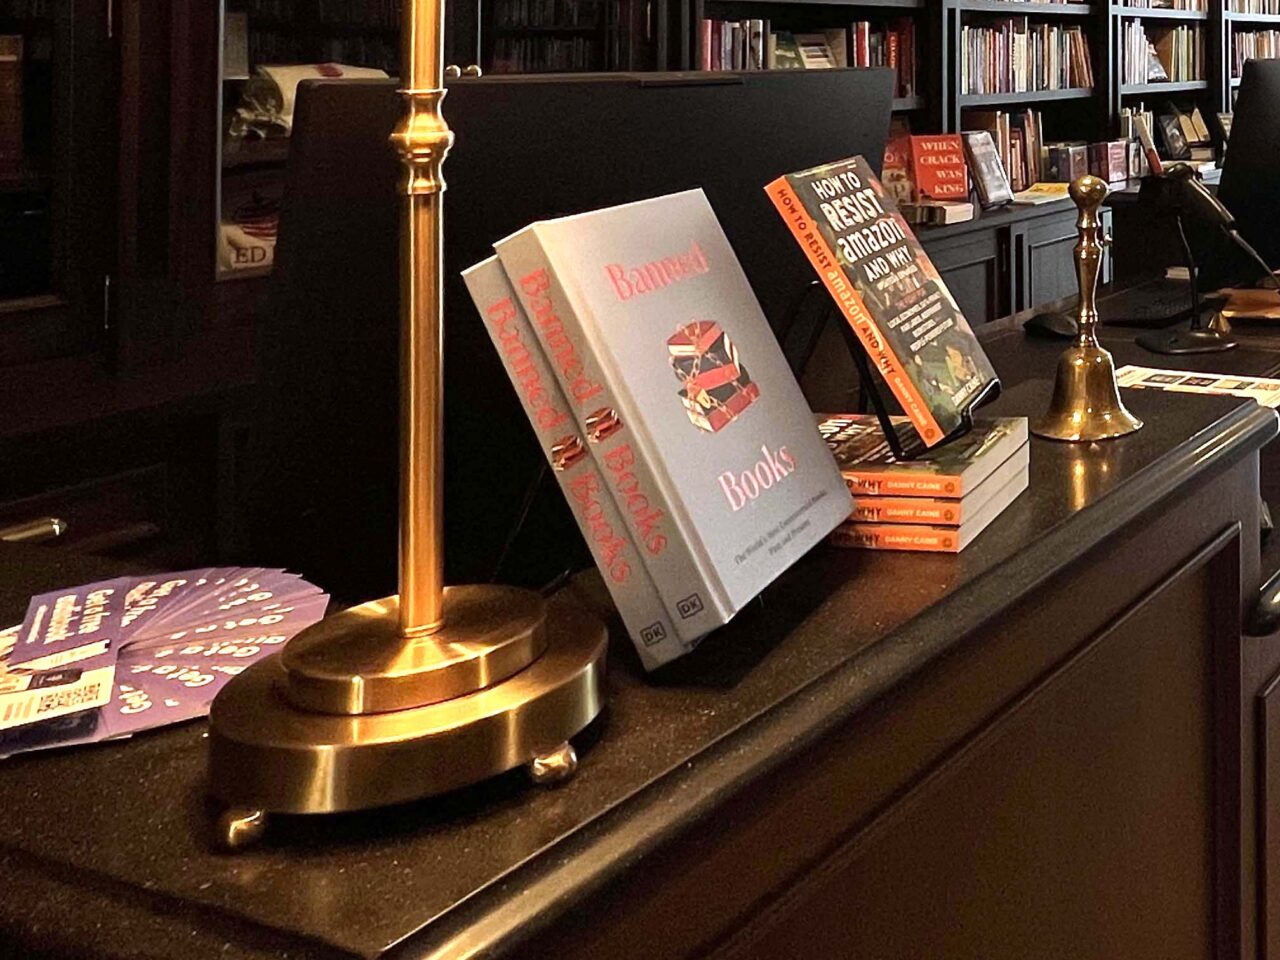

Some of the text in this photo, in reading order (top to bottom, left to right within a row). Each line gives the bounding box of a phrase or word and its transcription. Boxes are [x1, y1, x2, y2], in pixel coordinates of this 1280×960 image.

[920, 154, 961, 165] CRACK
[921, 140, 960, 152] WHEN
[811, 171, 861, 200] HOW TO
[934, 183, 964, 194] KING
[936, 169, 963, 179] WAS
[820, 188, 884, 232] RESIST
[837, 219, 907, 264] amazon
[604, 239, 711, 302] Banned
[862, 256, 890, 282] AND
[886, 244, 913, 268] WHY
[777, 188, 929, 428] HOW TO RESIST amazon AND WHY DANNY CAINE
[519, 267, 669, 557] Banned Books
[486, 297, 633, 585] Banned Books
[716, 442, 798, 512] Books
[857, 479, 884, 490] WHY
[887, 482, 915, 490] DANNY
[916, 482, 941, 491] CAINE
[857, 506, 940, 518] WHY DANNY CAINE
[885, 534, 913, 543] DANNY
[913, 536, 938, 544] CAINE
